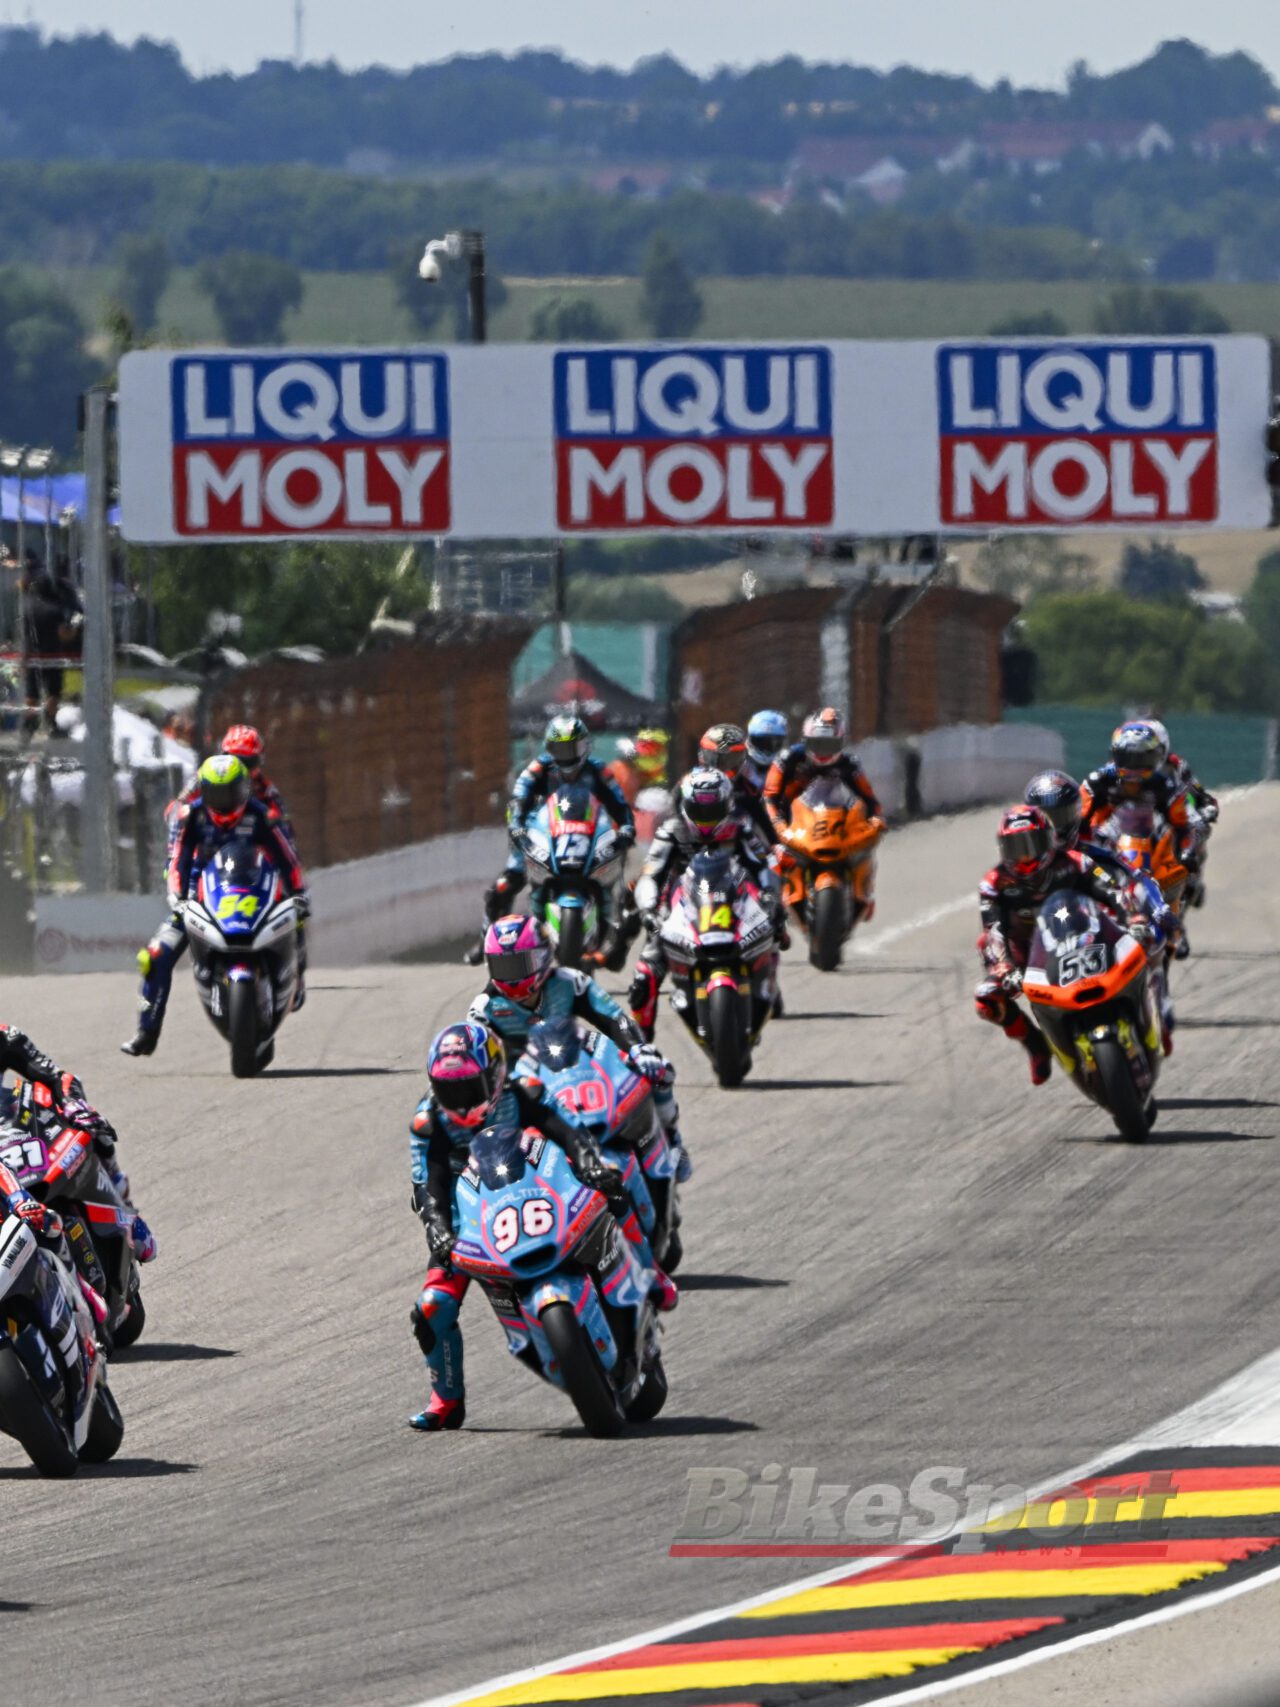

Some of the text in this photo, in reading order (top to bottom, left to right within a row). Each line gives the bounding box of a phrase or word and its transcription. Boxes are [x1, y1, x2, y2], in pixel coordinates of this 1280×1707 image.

[184, 360, 436, 441] LIQUI
[566, 352, 819, 436] LIQUI
[949, 350, 1204, 433] LIQUI
[186, 449, 445, 529] MOLY
[568, 439, 828, 523] MOLY
[952, 437, 1212, 520] MOLY
[215, 894, 260, 919] 54
[699, 904, 732, 933] 14
[1058, 943, 1107, 988] 53
[493, 1198, 555, 1254] 96
